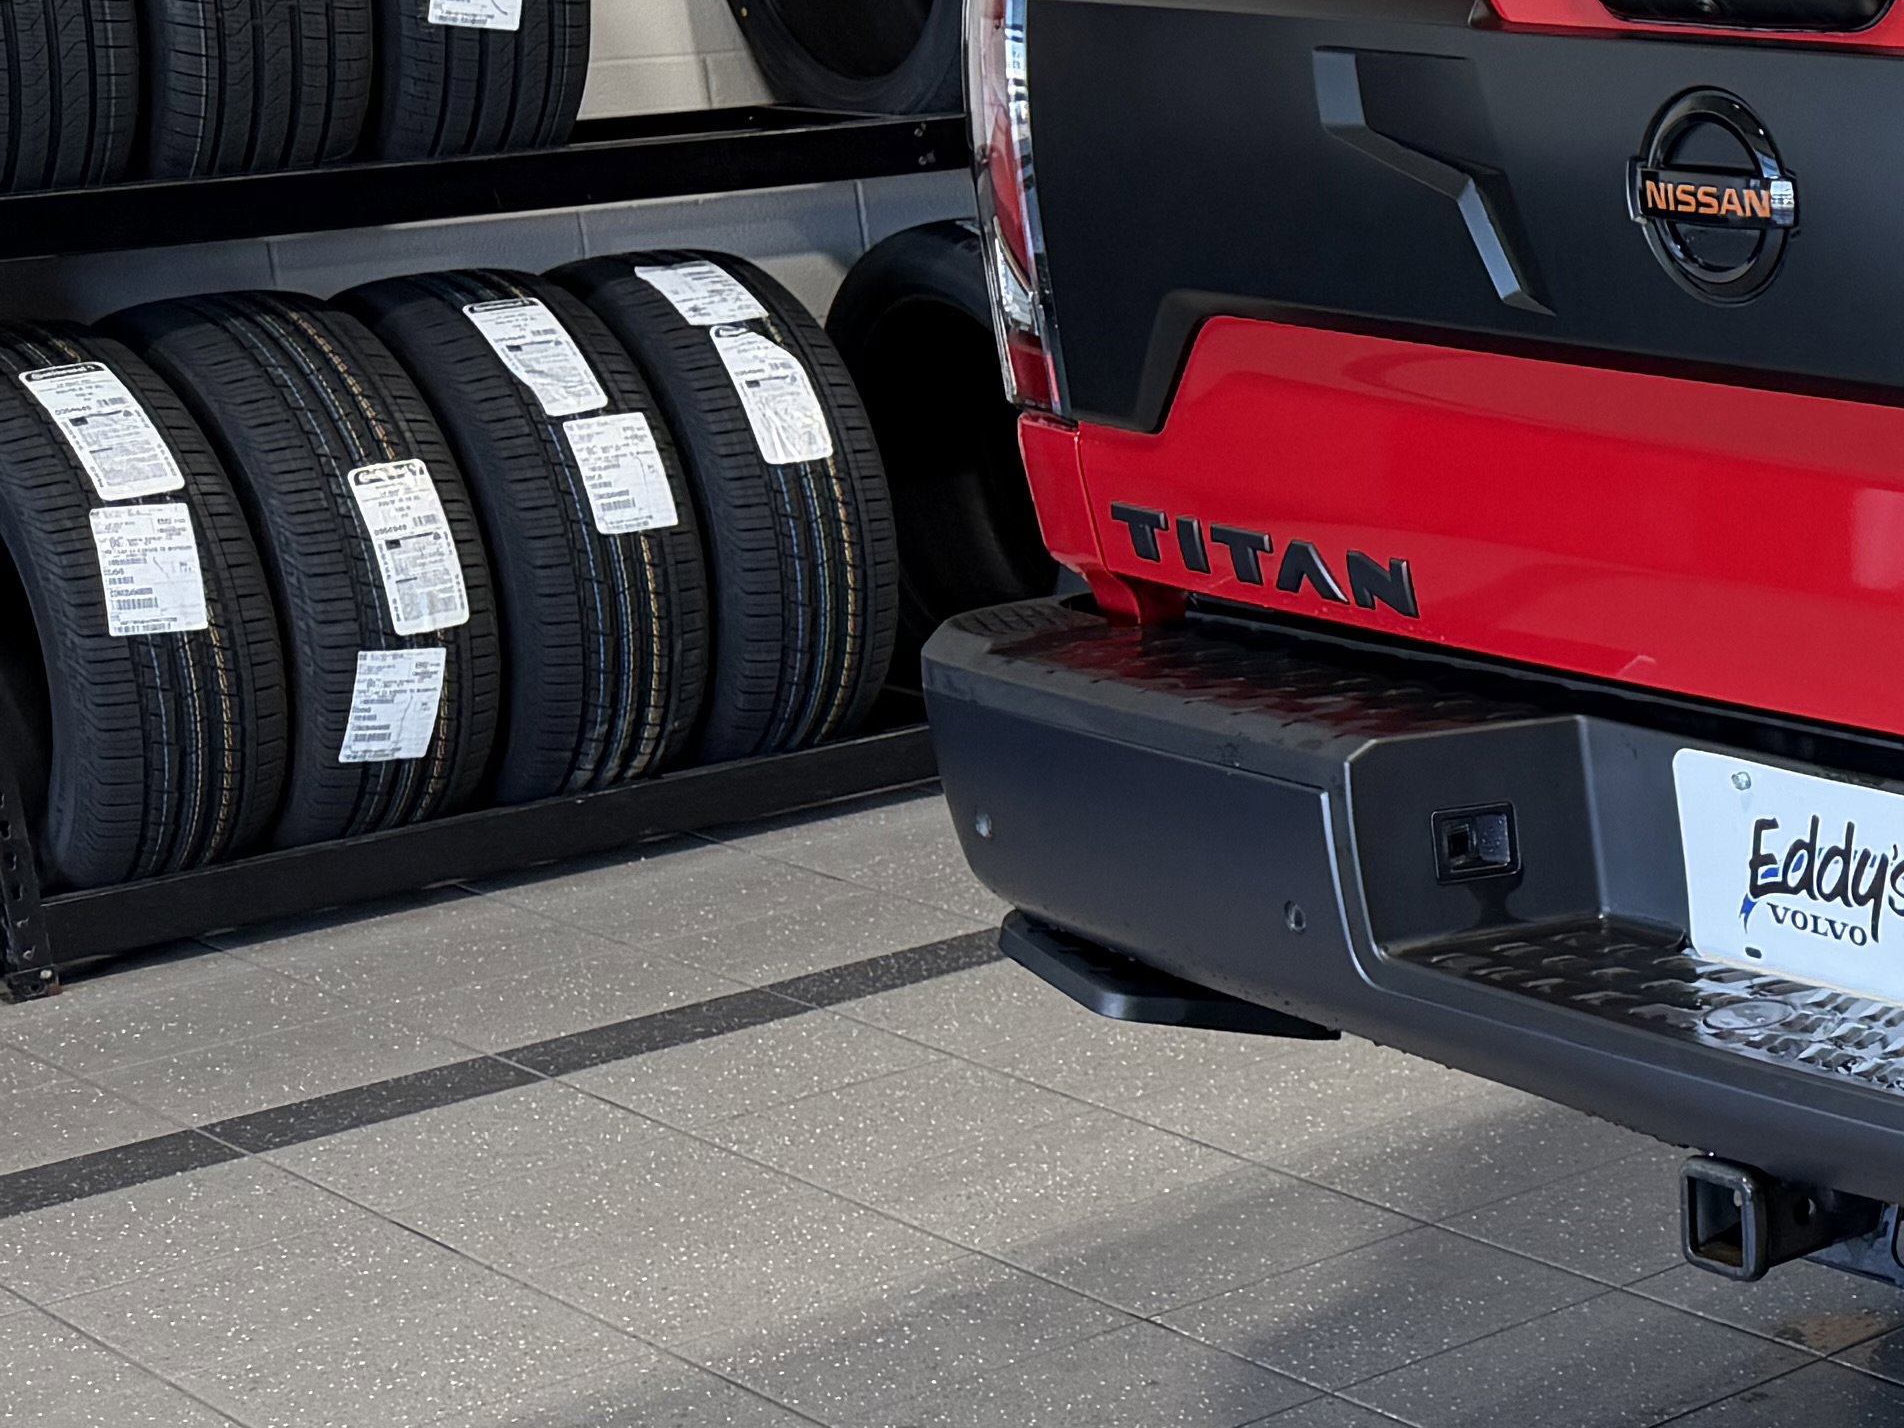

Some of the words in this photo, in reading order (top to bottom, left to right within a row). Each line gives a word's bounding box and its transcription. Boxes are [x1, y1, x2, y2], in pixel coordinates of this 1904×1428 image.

[1645, 180, 1772, 219] NISSAN
[1110, 501, 1420, 620] TITAN
[1766, 901, 1868, 947] VOLVO
